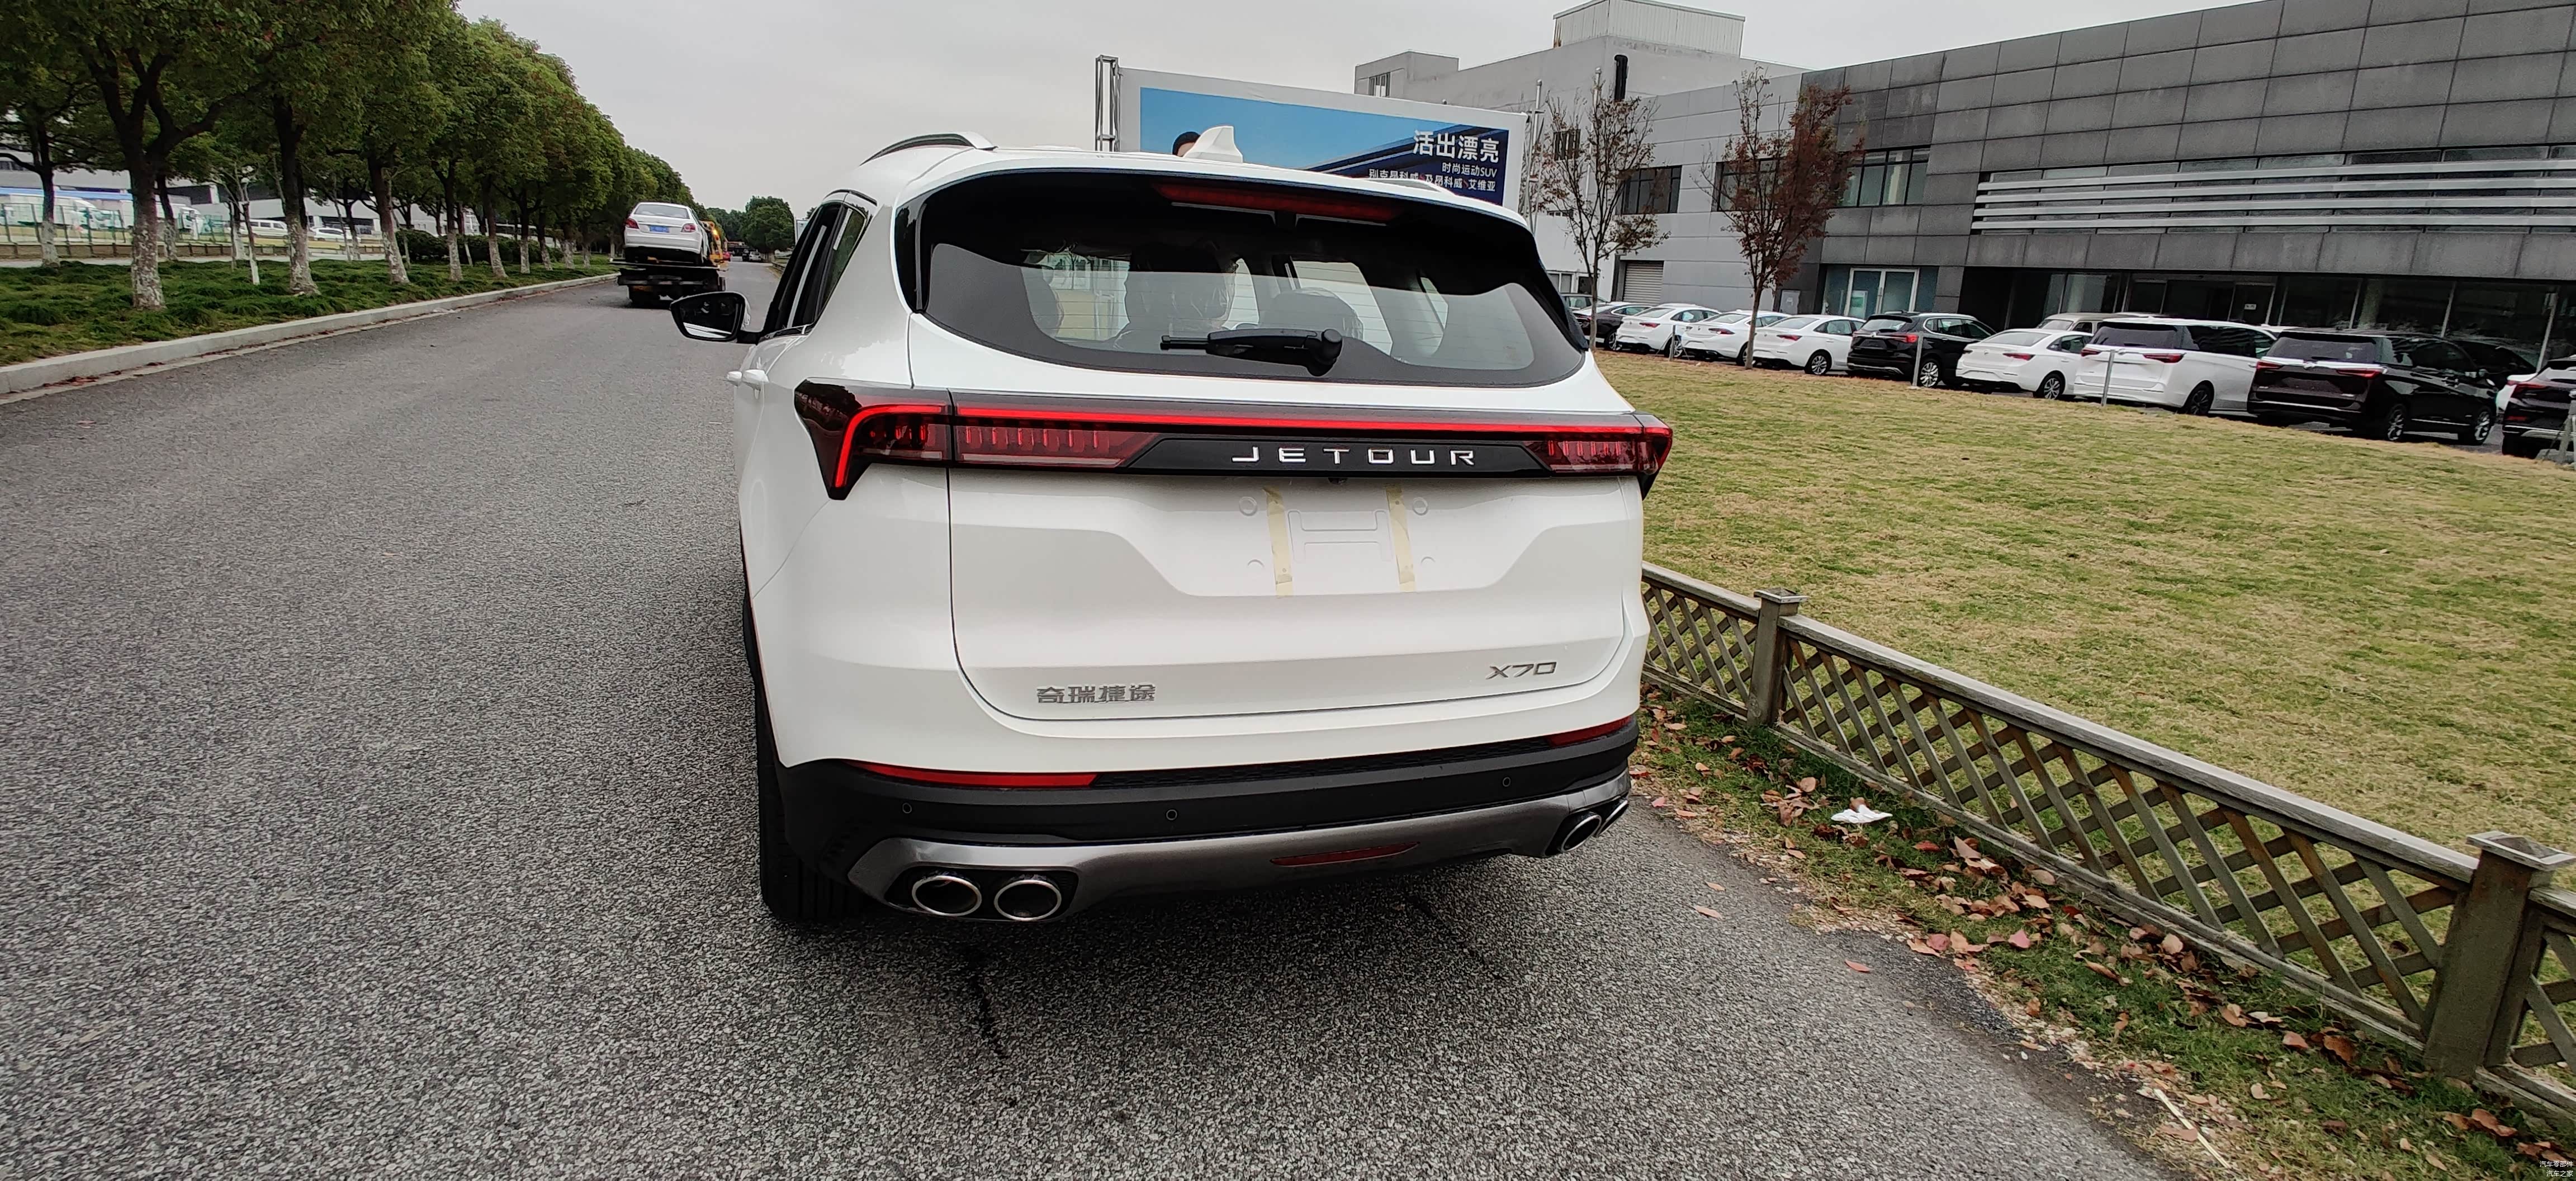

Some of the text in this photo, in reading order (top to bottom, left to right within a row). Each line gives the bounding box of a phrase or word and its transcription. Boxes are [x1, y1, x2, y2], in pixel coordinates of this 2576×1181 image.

[1413, 130, 1499, 163] 活出漂亮
[1442, 163, 1497, 178] 时尚运动SUV
[1232, 447, 1474, 465] JETOUR
[1485, 662, 1557, 679] X70
[1037, 683, 1156, 703] 奇瑞捷途
